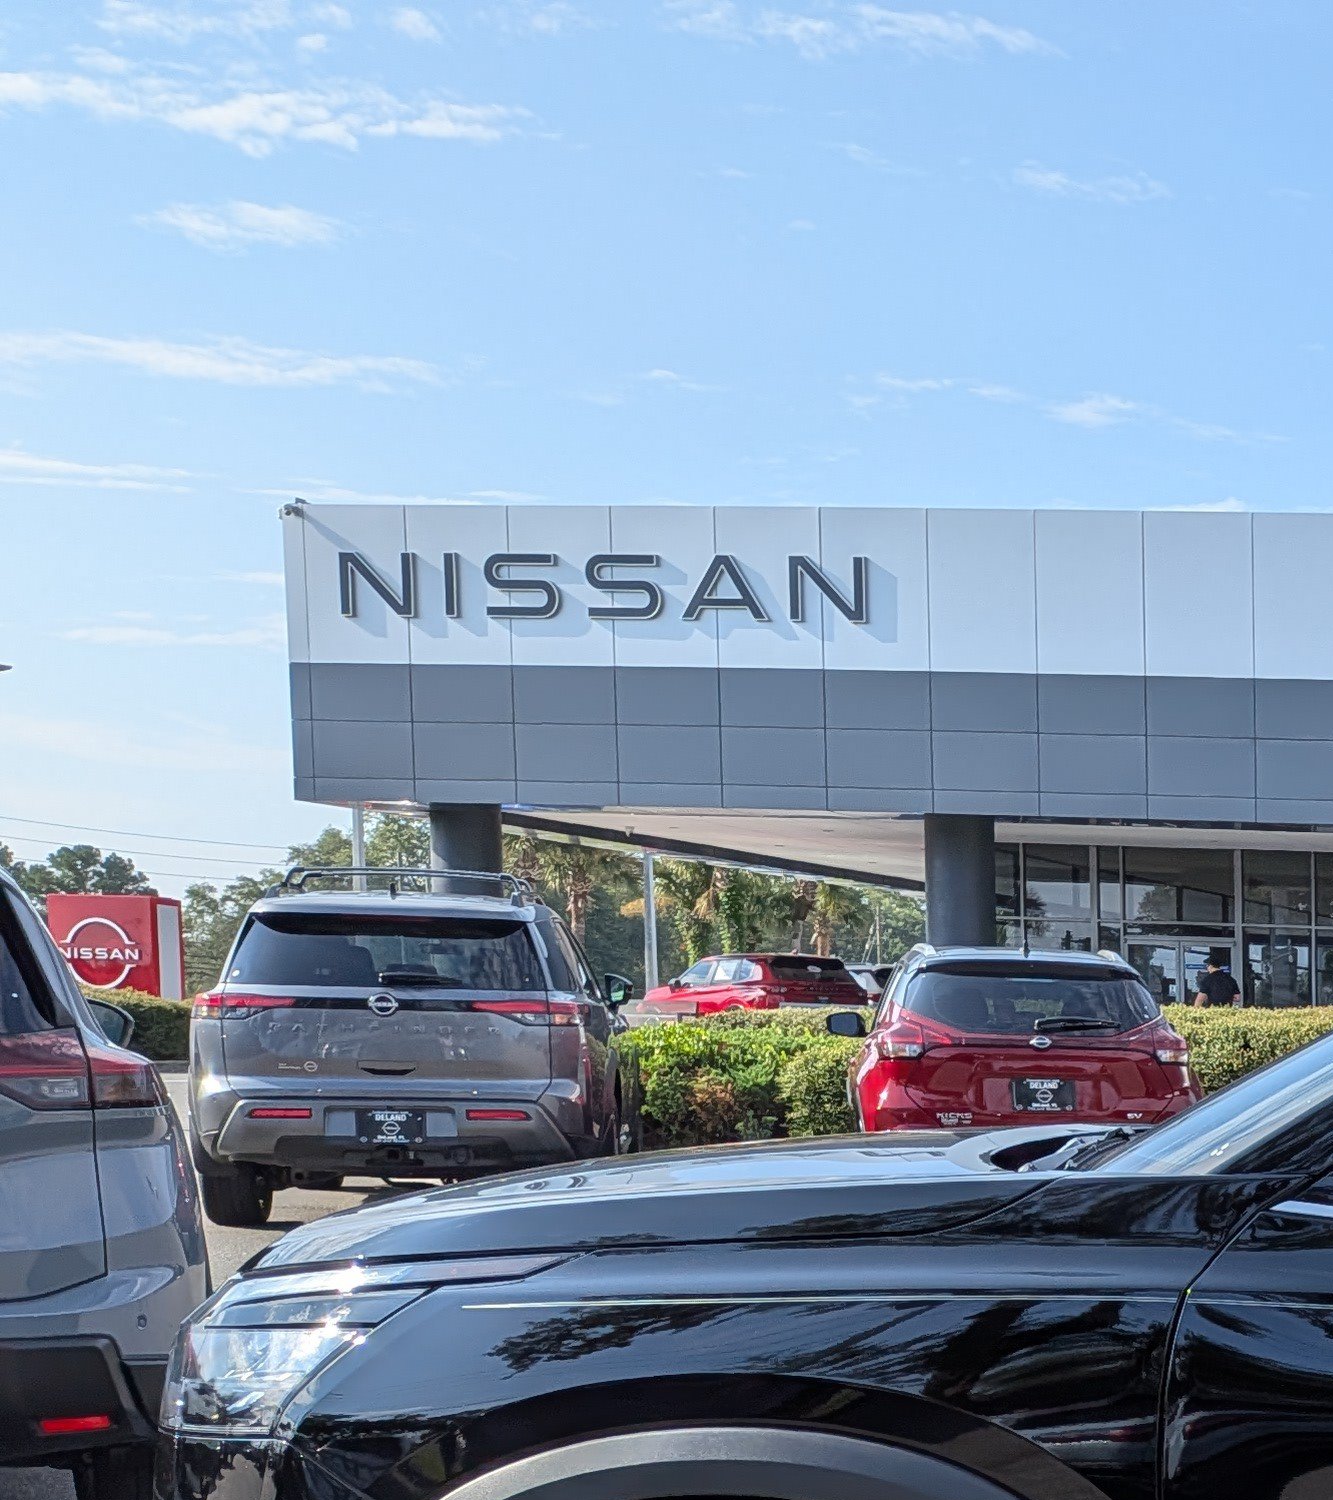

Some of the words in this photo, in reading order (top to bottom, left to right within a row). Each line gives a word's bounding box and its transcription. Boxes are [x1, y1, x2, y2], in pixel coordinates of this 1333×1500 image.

[337, 551, 868, 624] NISSAN
[58, 946, 140, 960] NISSAN
[374, 1113, 407, 1122] DELAND
[1126, 1112, 1143, 1120] SV
